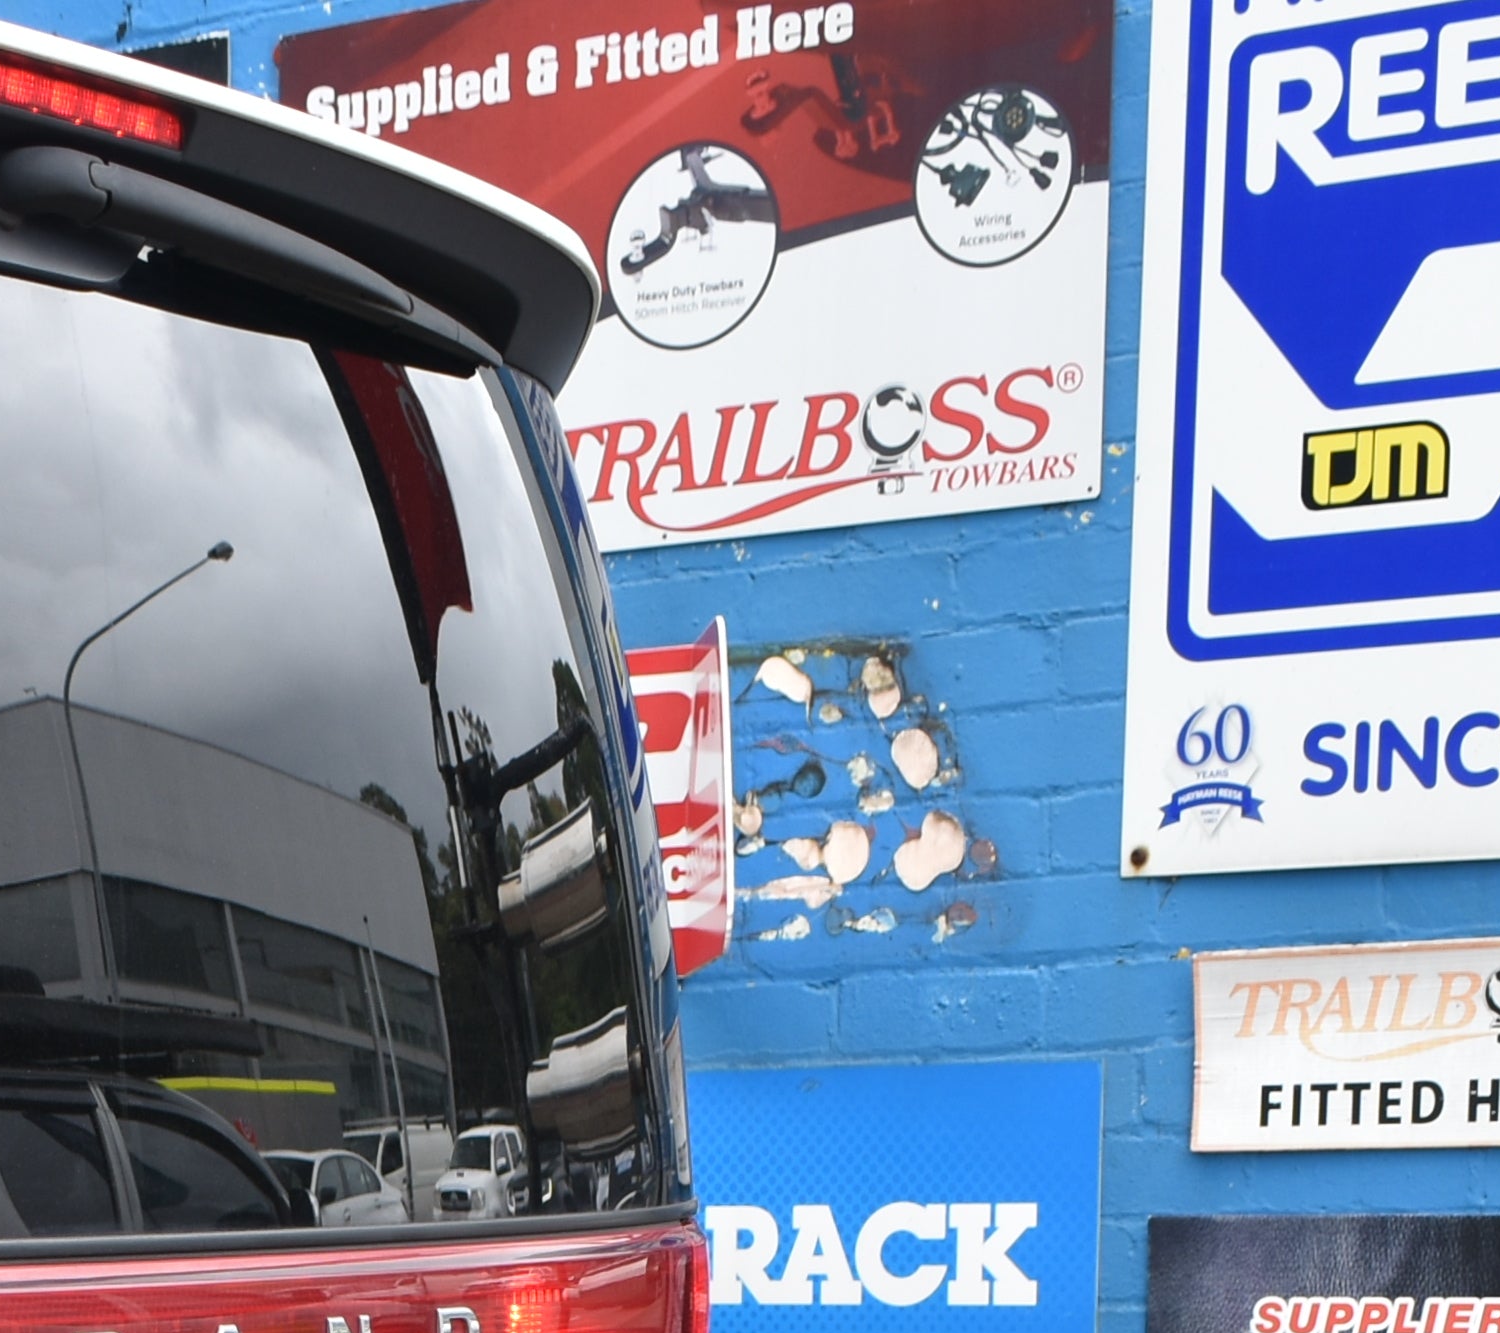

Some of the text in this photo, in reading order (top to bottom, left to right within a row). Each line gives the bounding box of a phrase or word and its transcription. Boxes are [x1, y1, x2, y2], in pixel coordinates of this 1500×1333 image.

[306, 2, 854, 136] Supplied & Fitted Here
[959, 229, 1026, 247] Accessories
[974, 213, 1012, 227] Wiring
[637, 279, 744, 303] Heavy Duty Towbars
[930, 453, 1078, 493] TOWBARS
[1306, 421, 1446, 506] TJM
[1177, 703, 1251, 767] 60
[1259, 1080, 1444, 1128] FITTED
[704, 1201, 1038, 1306] RACK
